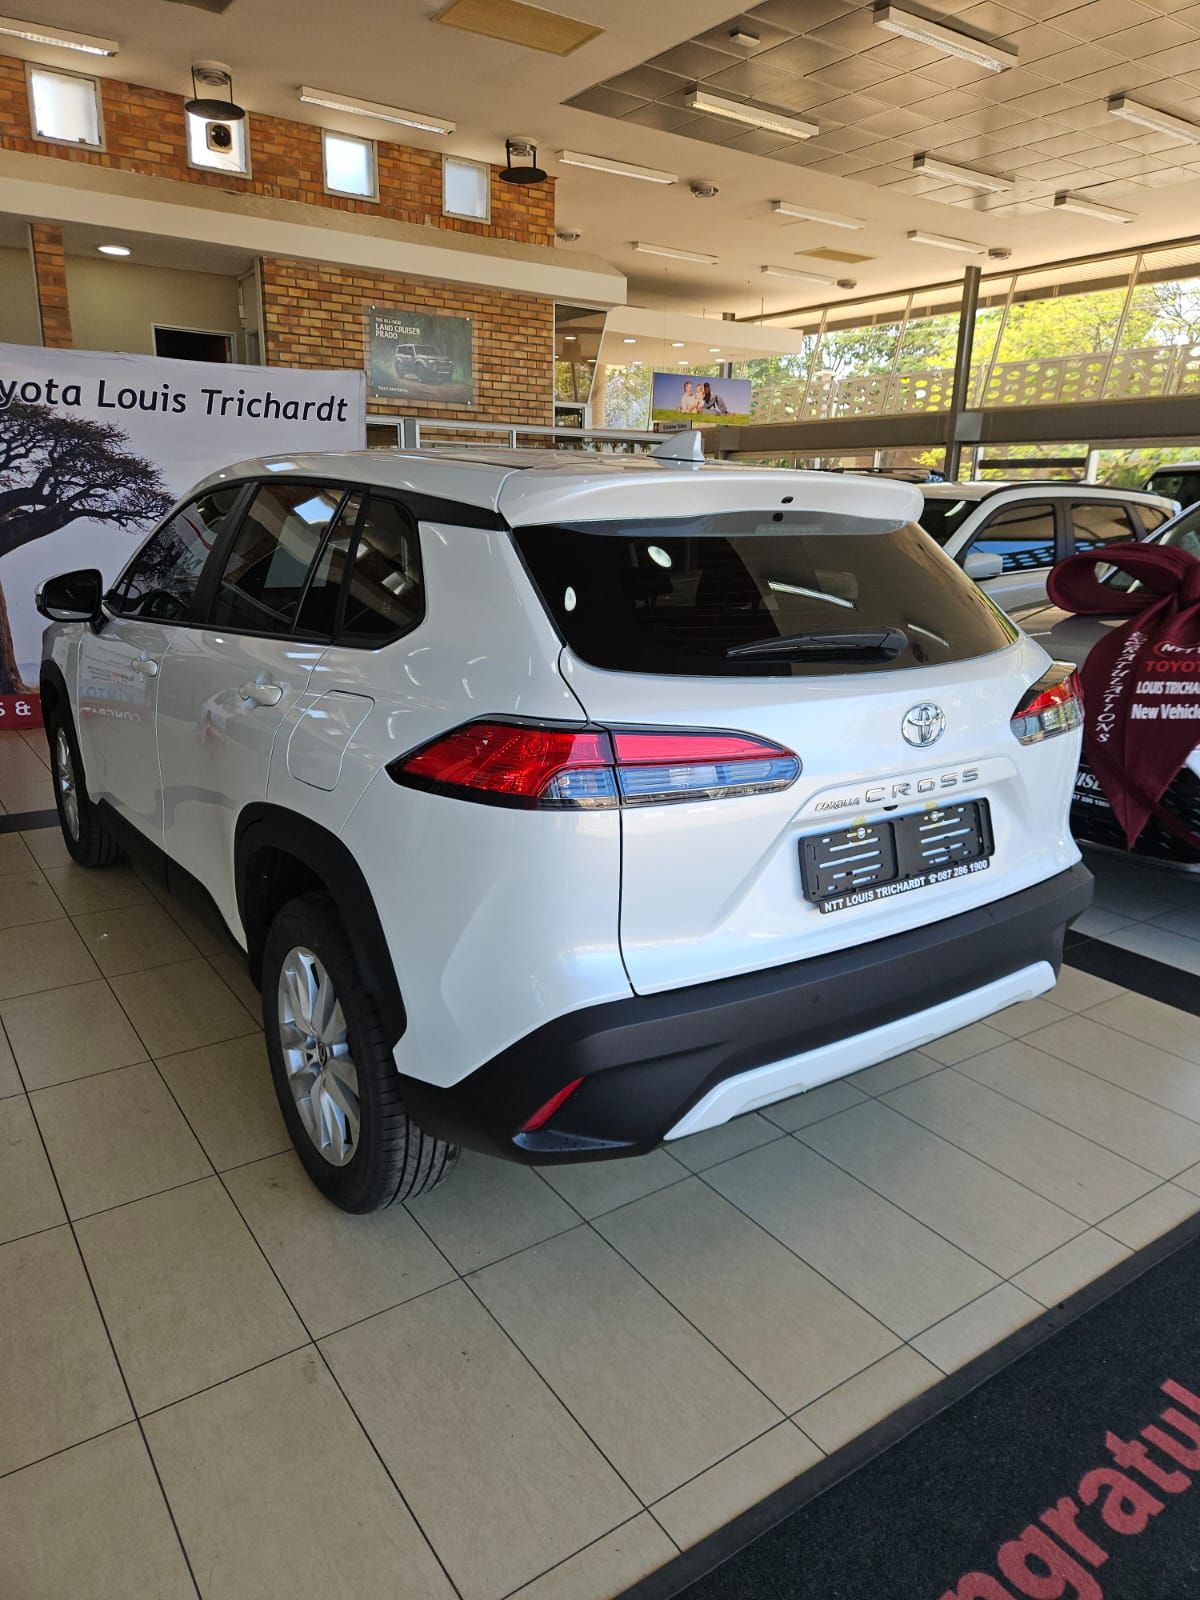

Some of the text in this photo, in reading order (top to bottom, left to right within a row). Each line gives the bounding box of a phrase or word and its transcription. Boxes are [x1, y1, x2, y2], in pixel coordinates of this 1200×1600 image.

[375, 323, 421, 336] LAND CRUISER
[375, 330, 398, 339] PRADO
[97, 380, 187, 413] Louis
[201, 388, 348, 422] Trichardt
[1136, 681, 1164, 694] LOUIS
[15, 700, 32, 716] &
[1131, 704, 1159, 719] New
[865, 768, 979, 803] CROSS
[824, 859, 988, 913] NTT LOUIS TRICHARDT 087 286 1900
